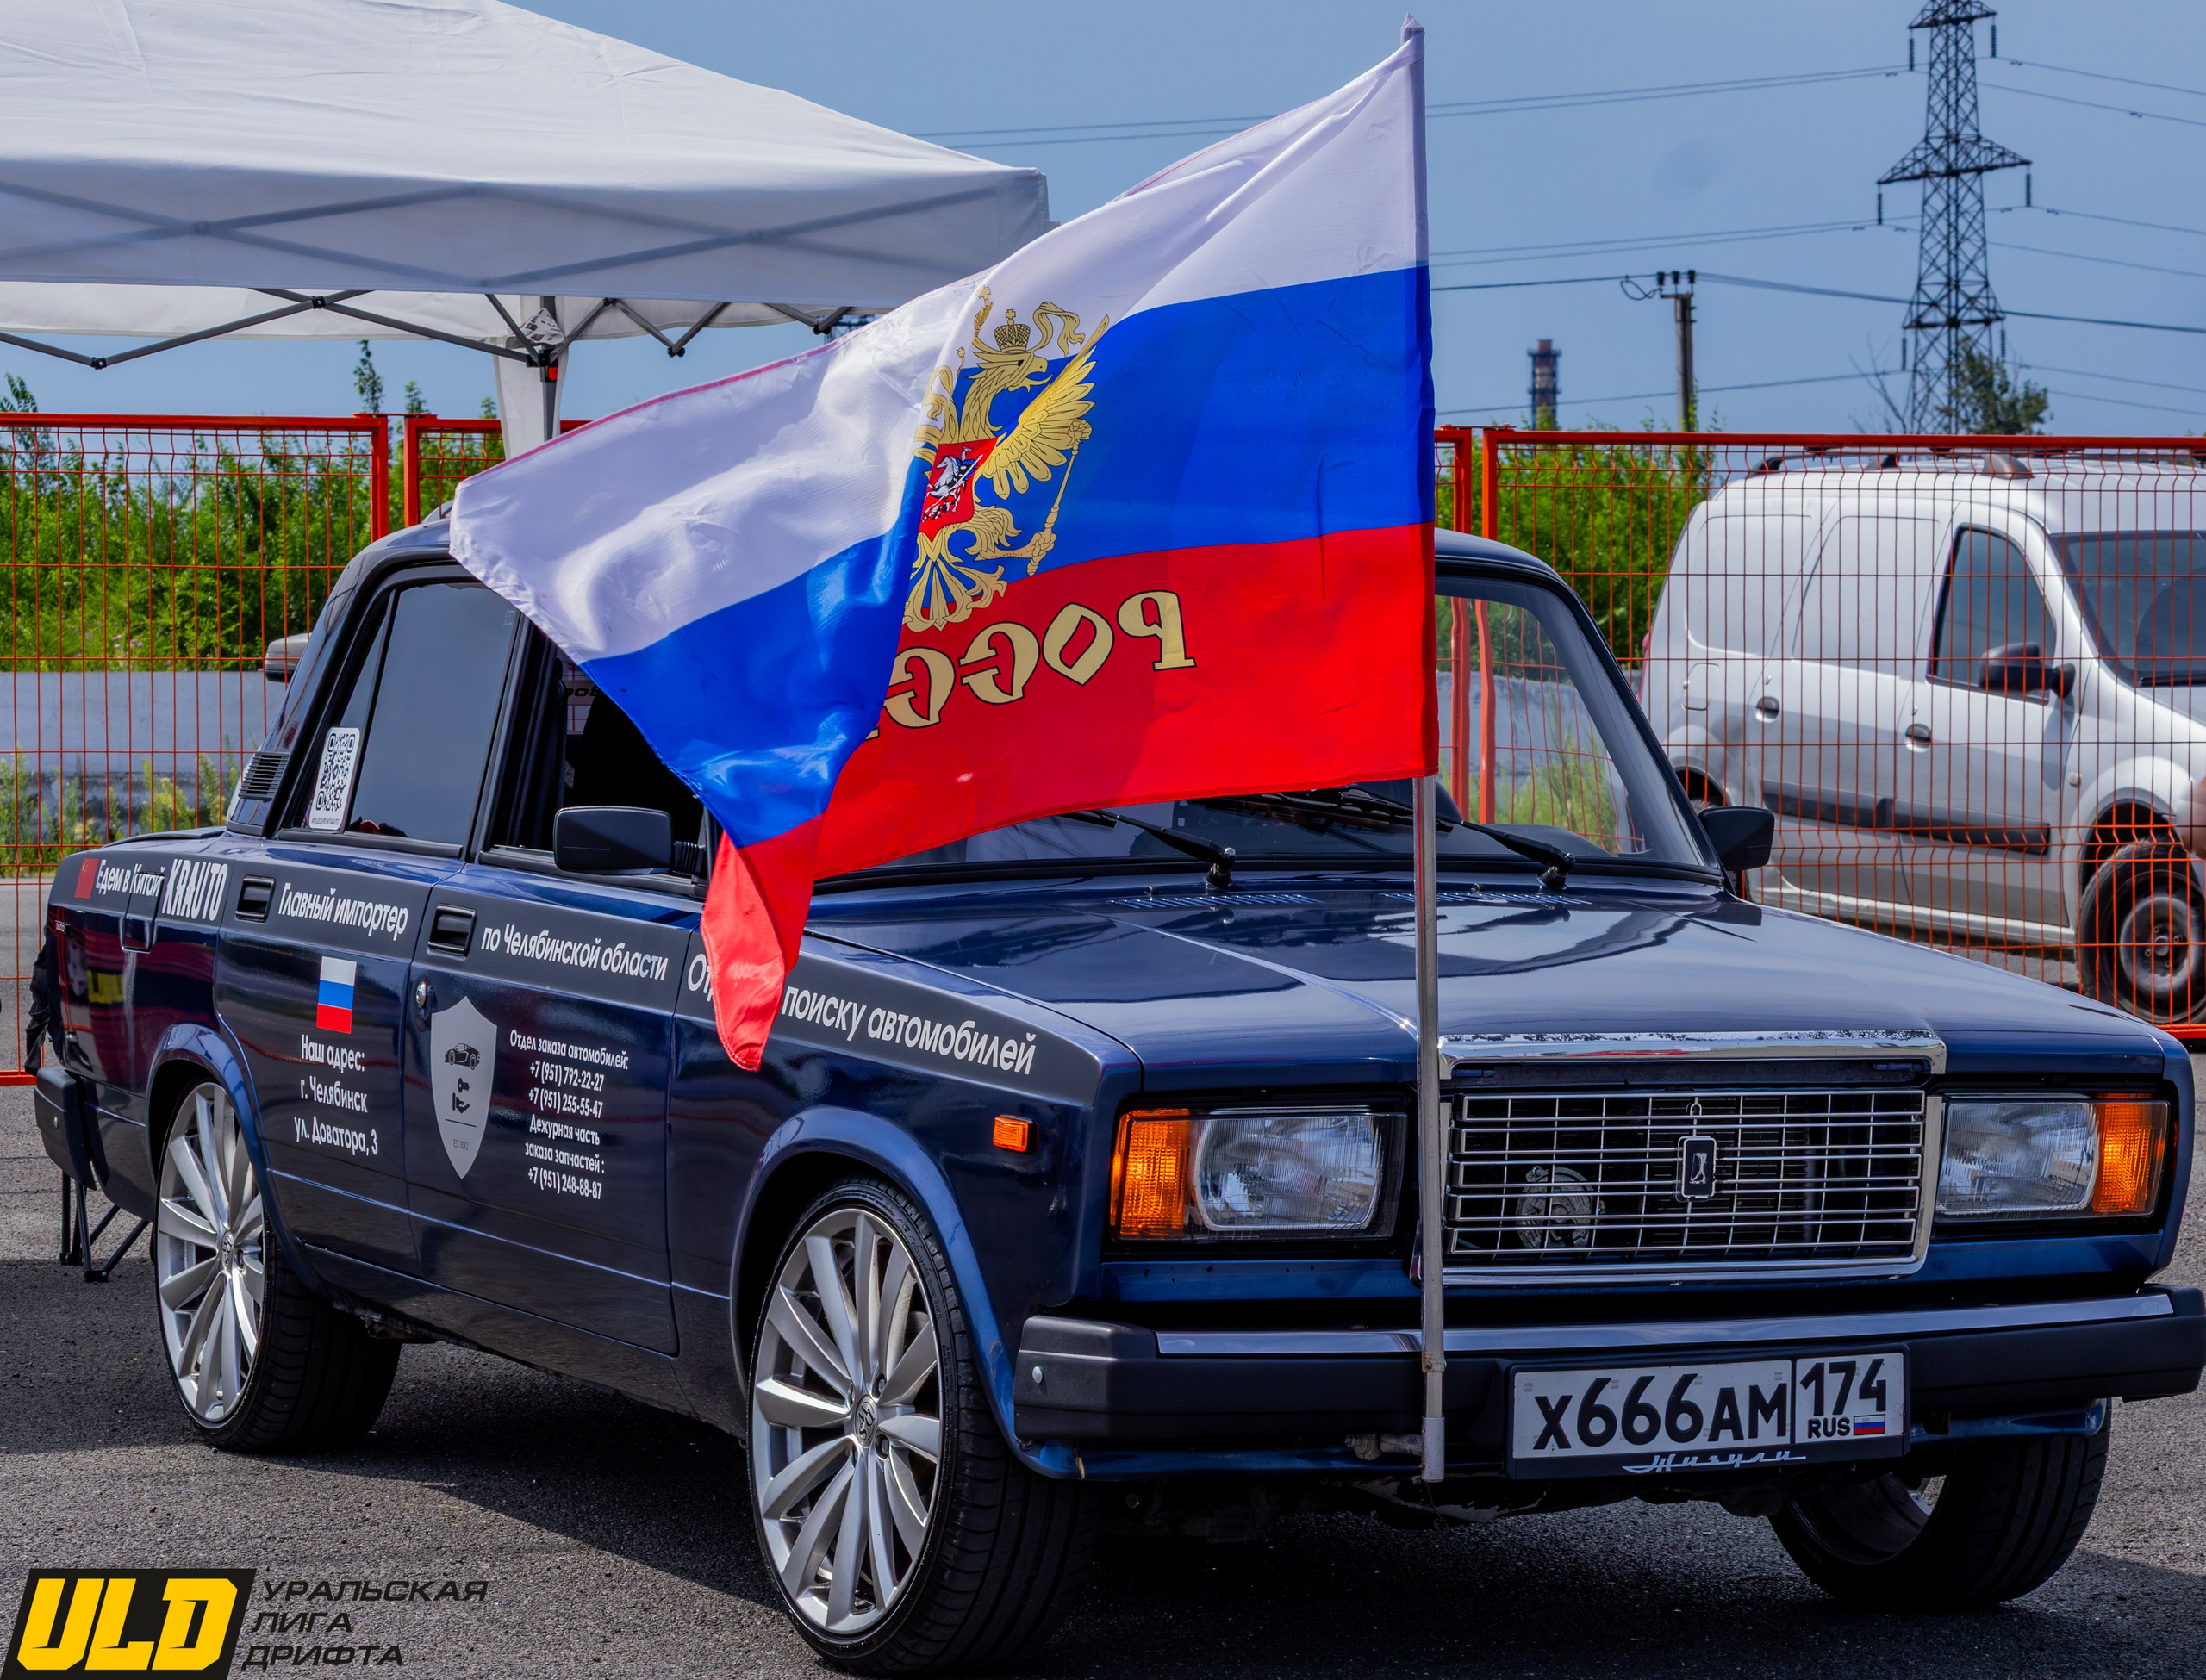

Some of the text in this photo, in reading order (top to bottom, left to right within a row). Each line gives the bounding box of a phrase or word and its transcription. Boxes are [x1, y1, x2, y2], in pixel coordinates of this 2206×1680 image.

[96, 859, 165, 897] Едем в Китай
[161, 858, 228, 921] KRAUTO
[278, 882, 408, 941] Главный импортер
[481, 924, 669, 981] по Челябинской области
[510, 1029, 629, 1070] Отдел заказа автомобилей:
[781, 986, 1037, 1075] поиску автомобилей
[301, 1034, 365, 1073] Наш адрес:
[300, 1075, 368, 1113] г. Челябинск
[529, 1061, 605, 1092] +7 (951) 792-22-27
[528, 1087, 603, 1119] +7 (951) 255-55-47
[294, 1116, 378, 1156] ул. Доватора, 3
[529, 1114, 601, 1146] Дежурная часть
[525, 1142, 553, 1161] заказа
[555, 1149, 601, 1173] запчастей
[527, 1167, 602, 1199] +7 (951) 248-88-87
[1799, 1359, 1886, 1416] 174
[1807, 1416, 1851, 1440] RUS
[1622, 1450, 1806, 1474] Жигули
